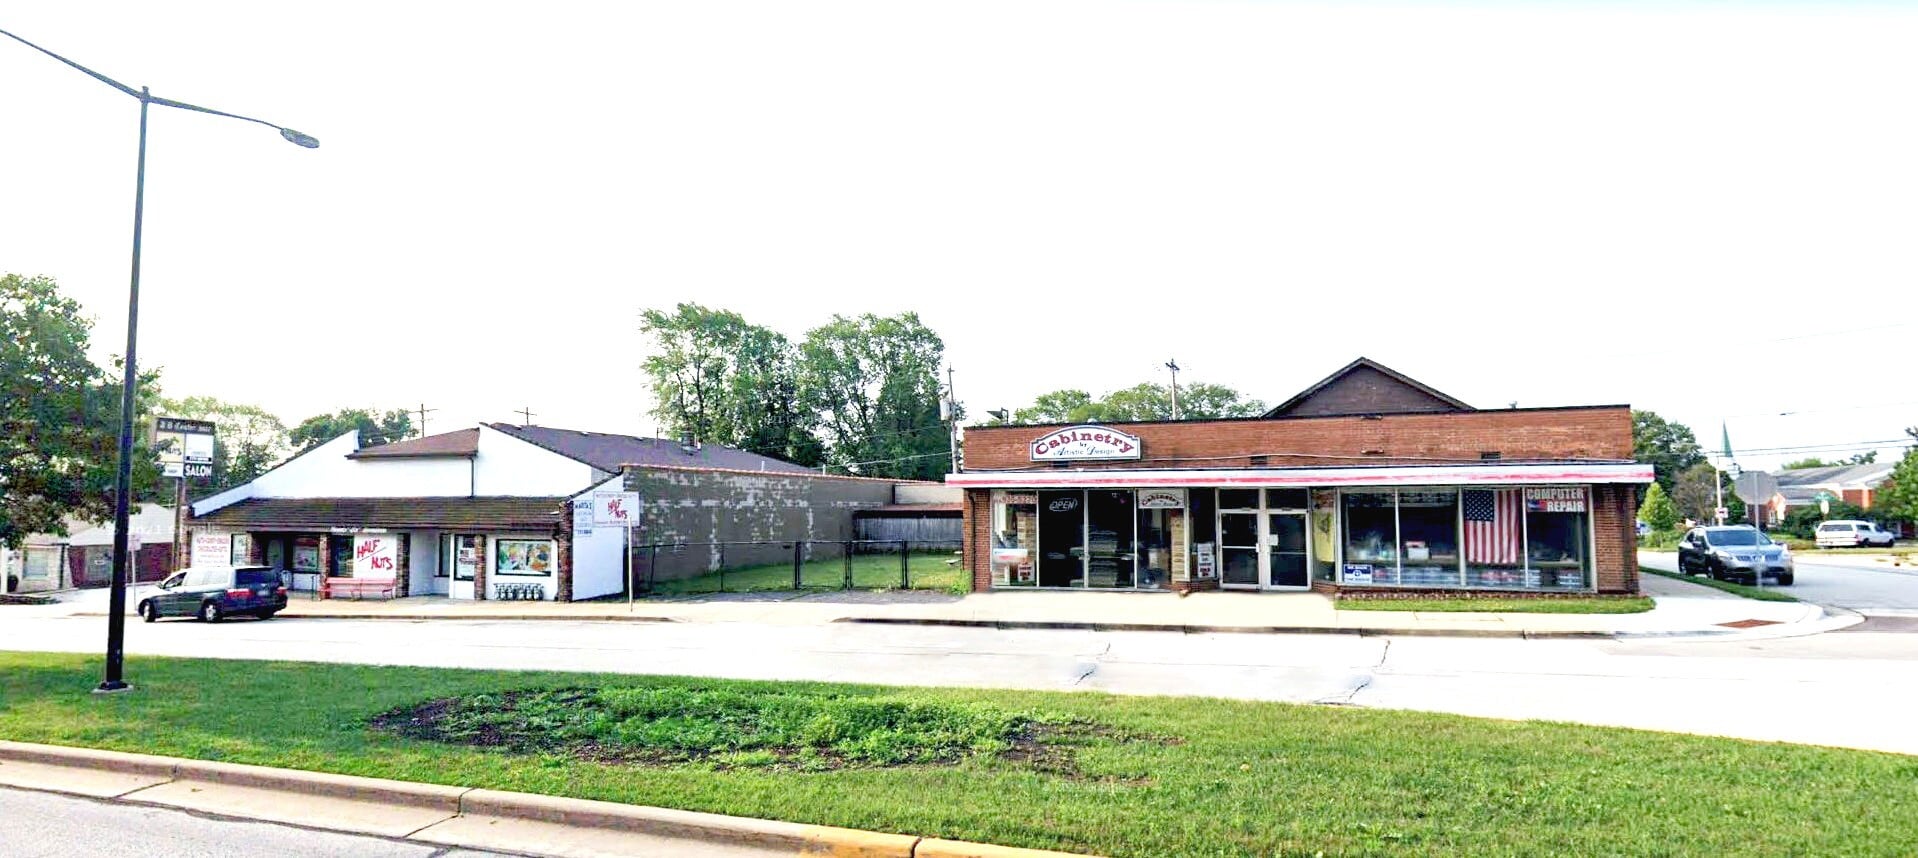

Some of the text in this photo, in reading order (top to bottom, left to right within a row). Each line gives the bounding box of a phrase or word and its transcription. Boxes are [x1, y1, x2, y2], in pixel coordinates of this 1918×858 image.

[1035, 431, 1134, 455] Cabinetry
[185, 464, 212, 476] SALON
[1527, 488, 1584, 499] COMPUTER
[607, 498, 623, 512] HALF
[1050, 499, 1075, 510] OPEN
[1142, 494, 1180, 506] Cabinetry
[1547, 500, 1585, 512] REPAIR
[615, 510, 628, 519] NUTS
[357, 539, 381, 558] HALF
[371, 556, 393, 570] NUTS
